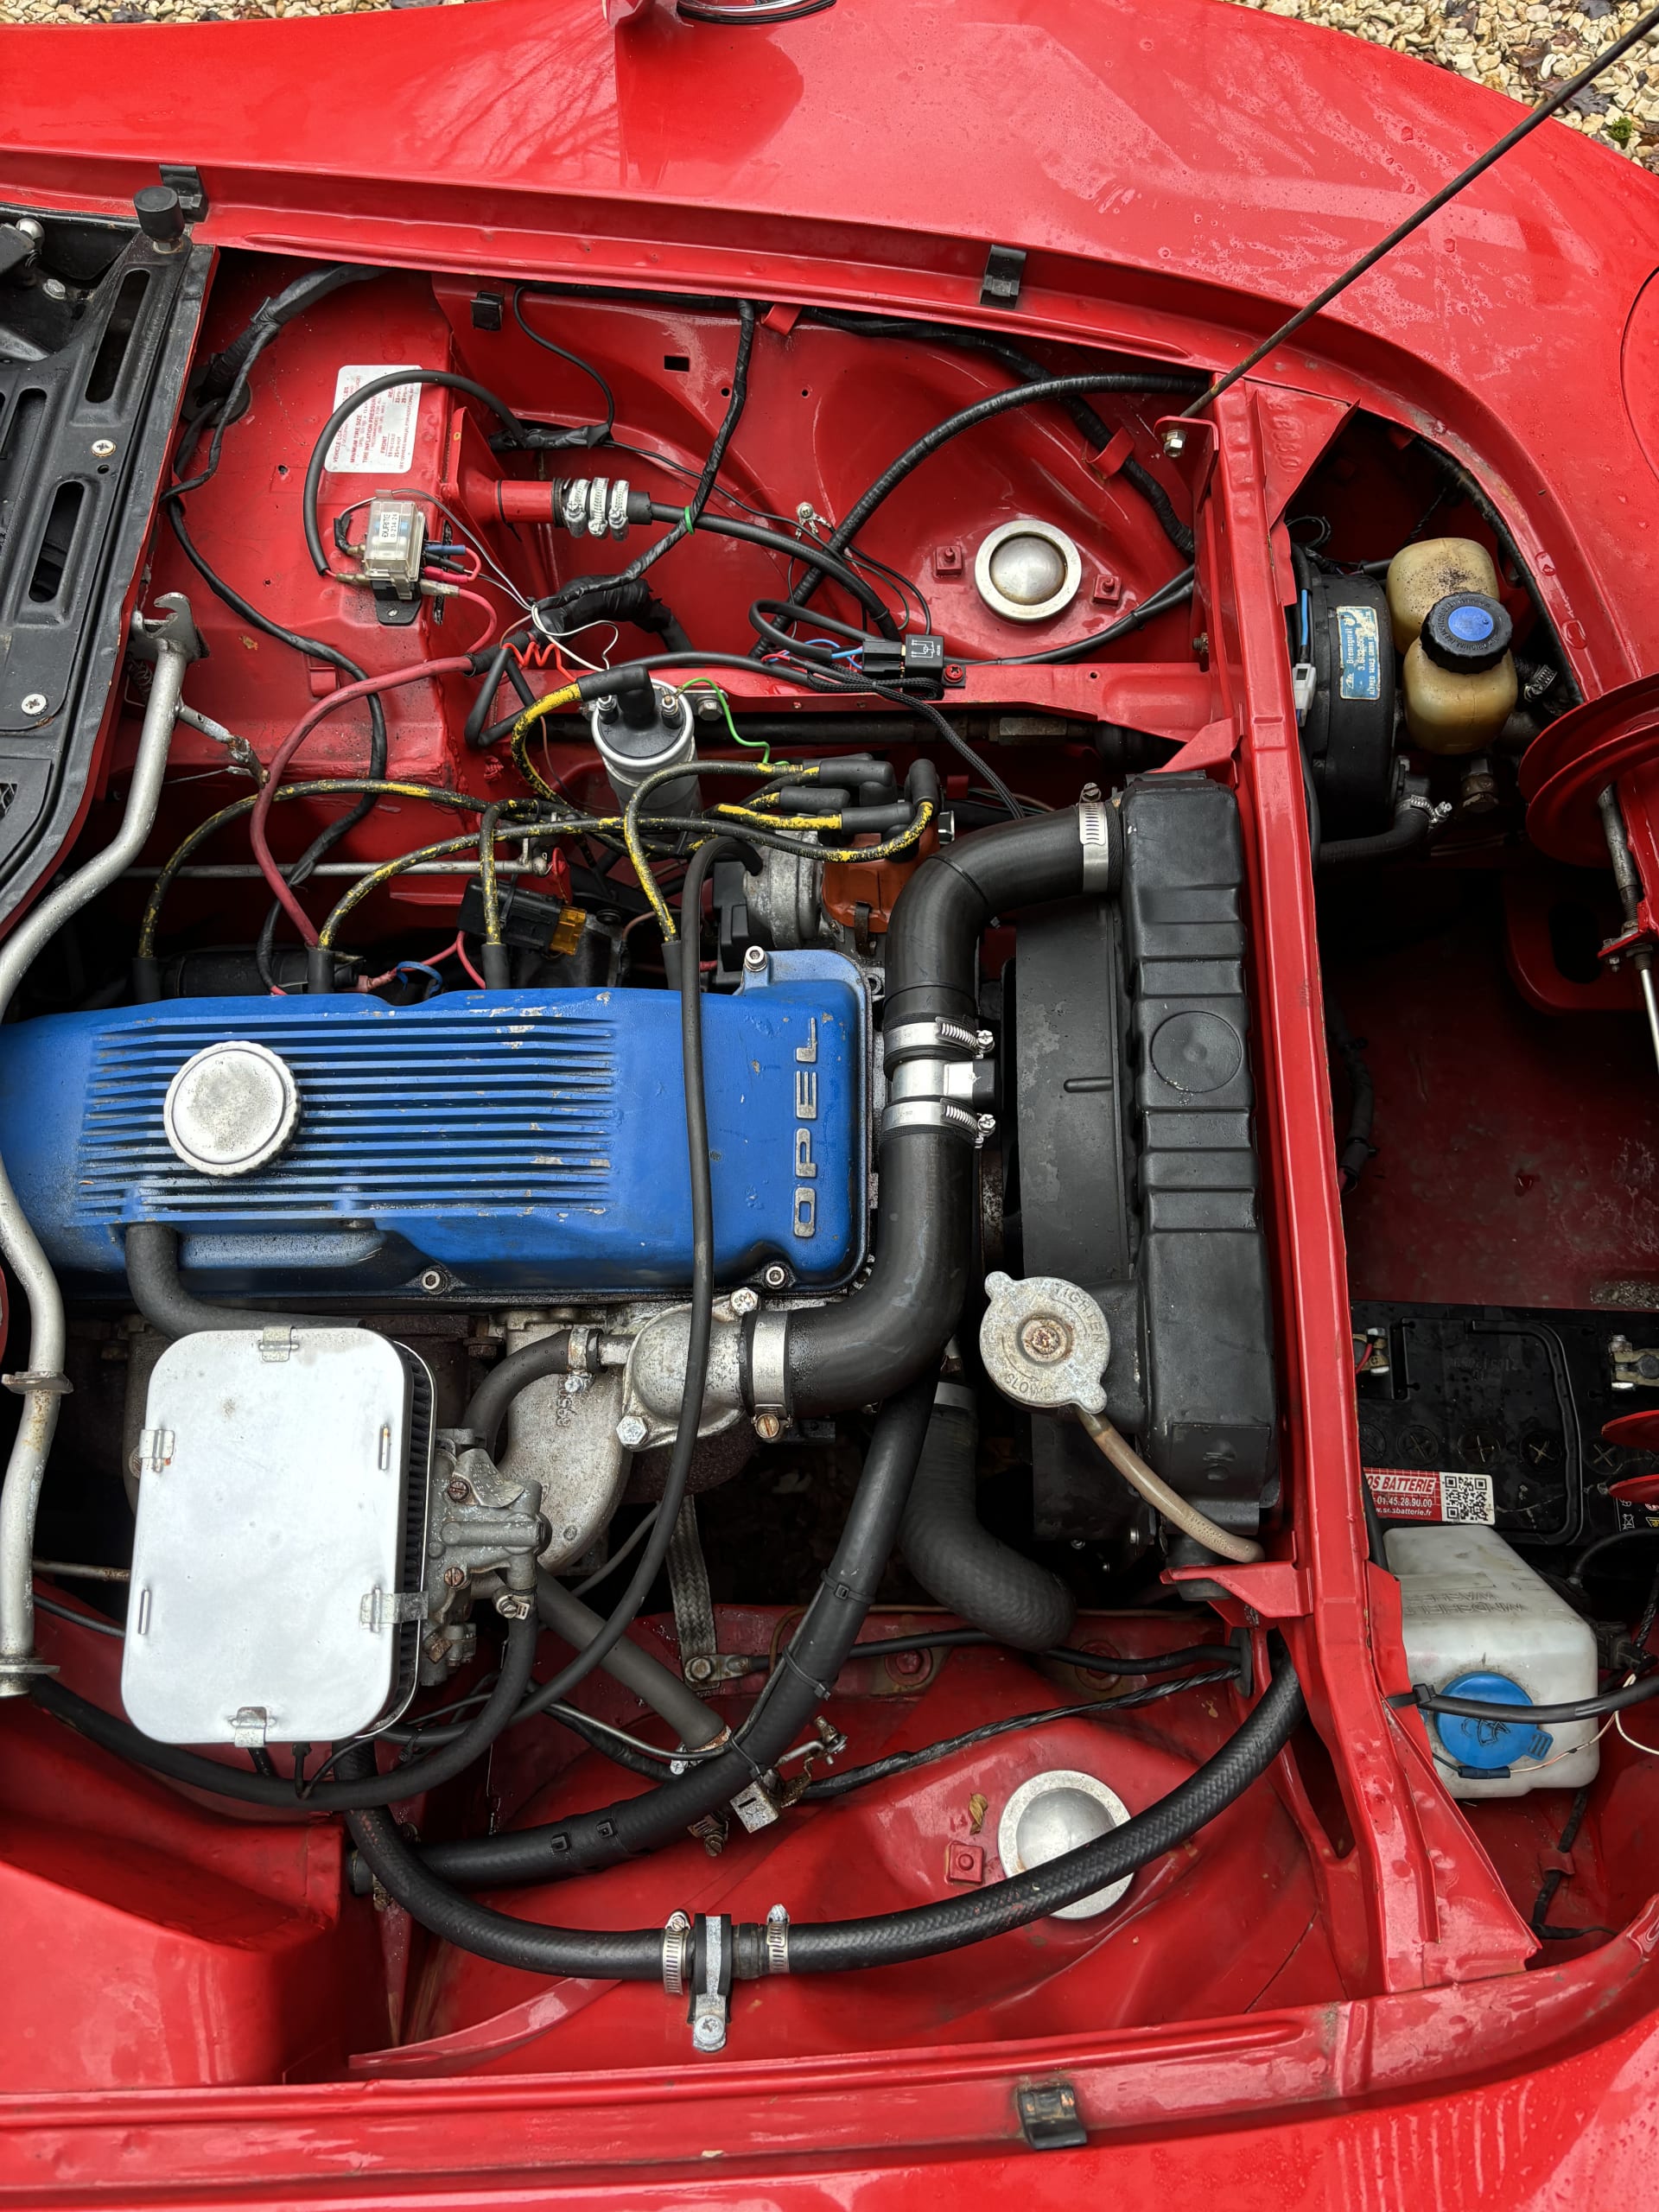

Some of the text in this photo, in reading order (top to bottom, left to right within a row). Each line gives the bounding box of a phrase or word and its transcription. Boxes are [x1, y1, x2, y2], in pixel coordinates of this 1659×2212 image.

[792, 1017, 818, 1238] OPEL
[1053, 1282, 1104, 1344] TIGHTEN
[1382, 1477, 1435, 1493] BATTERIE
